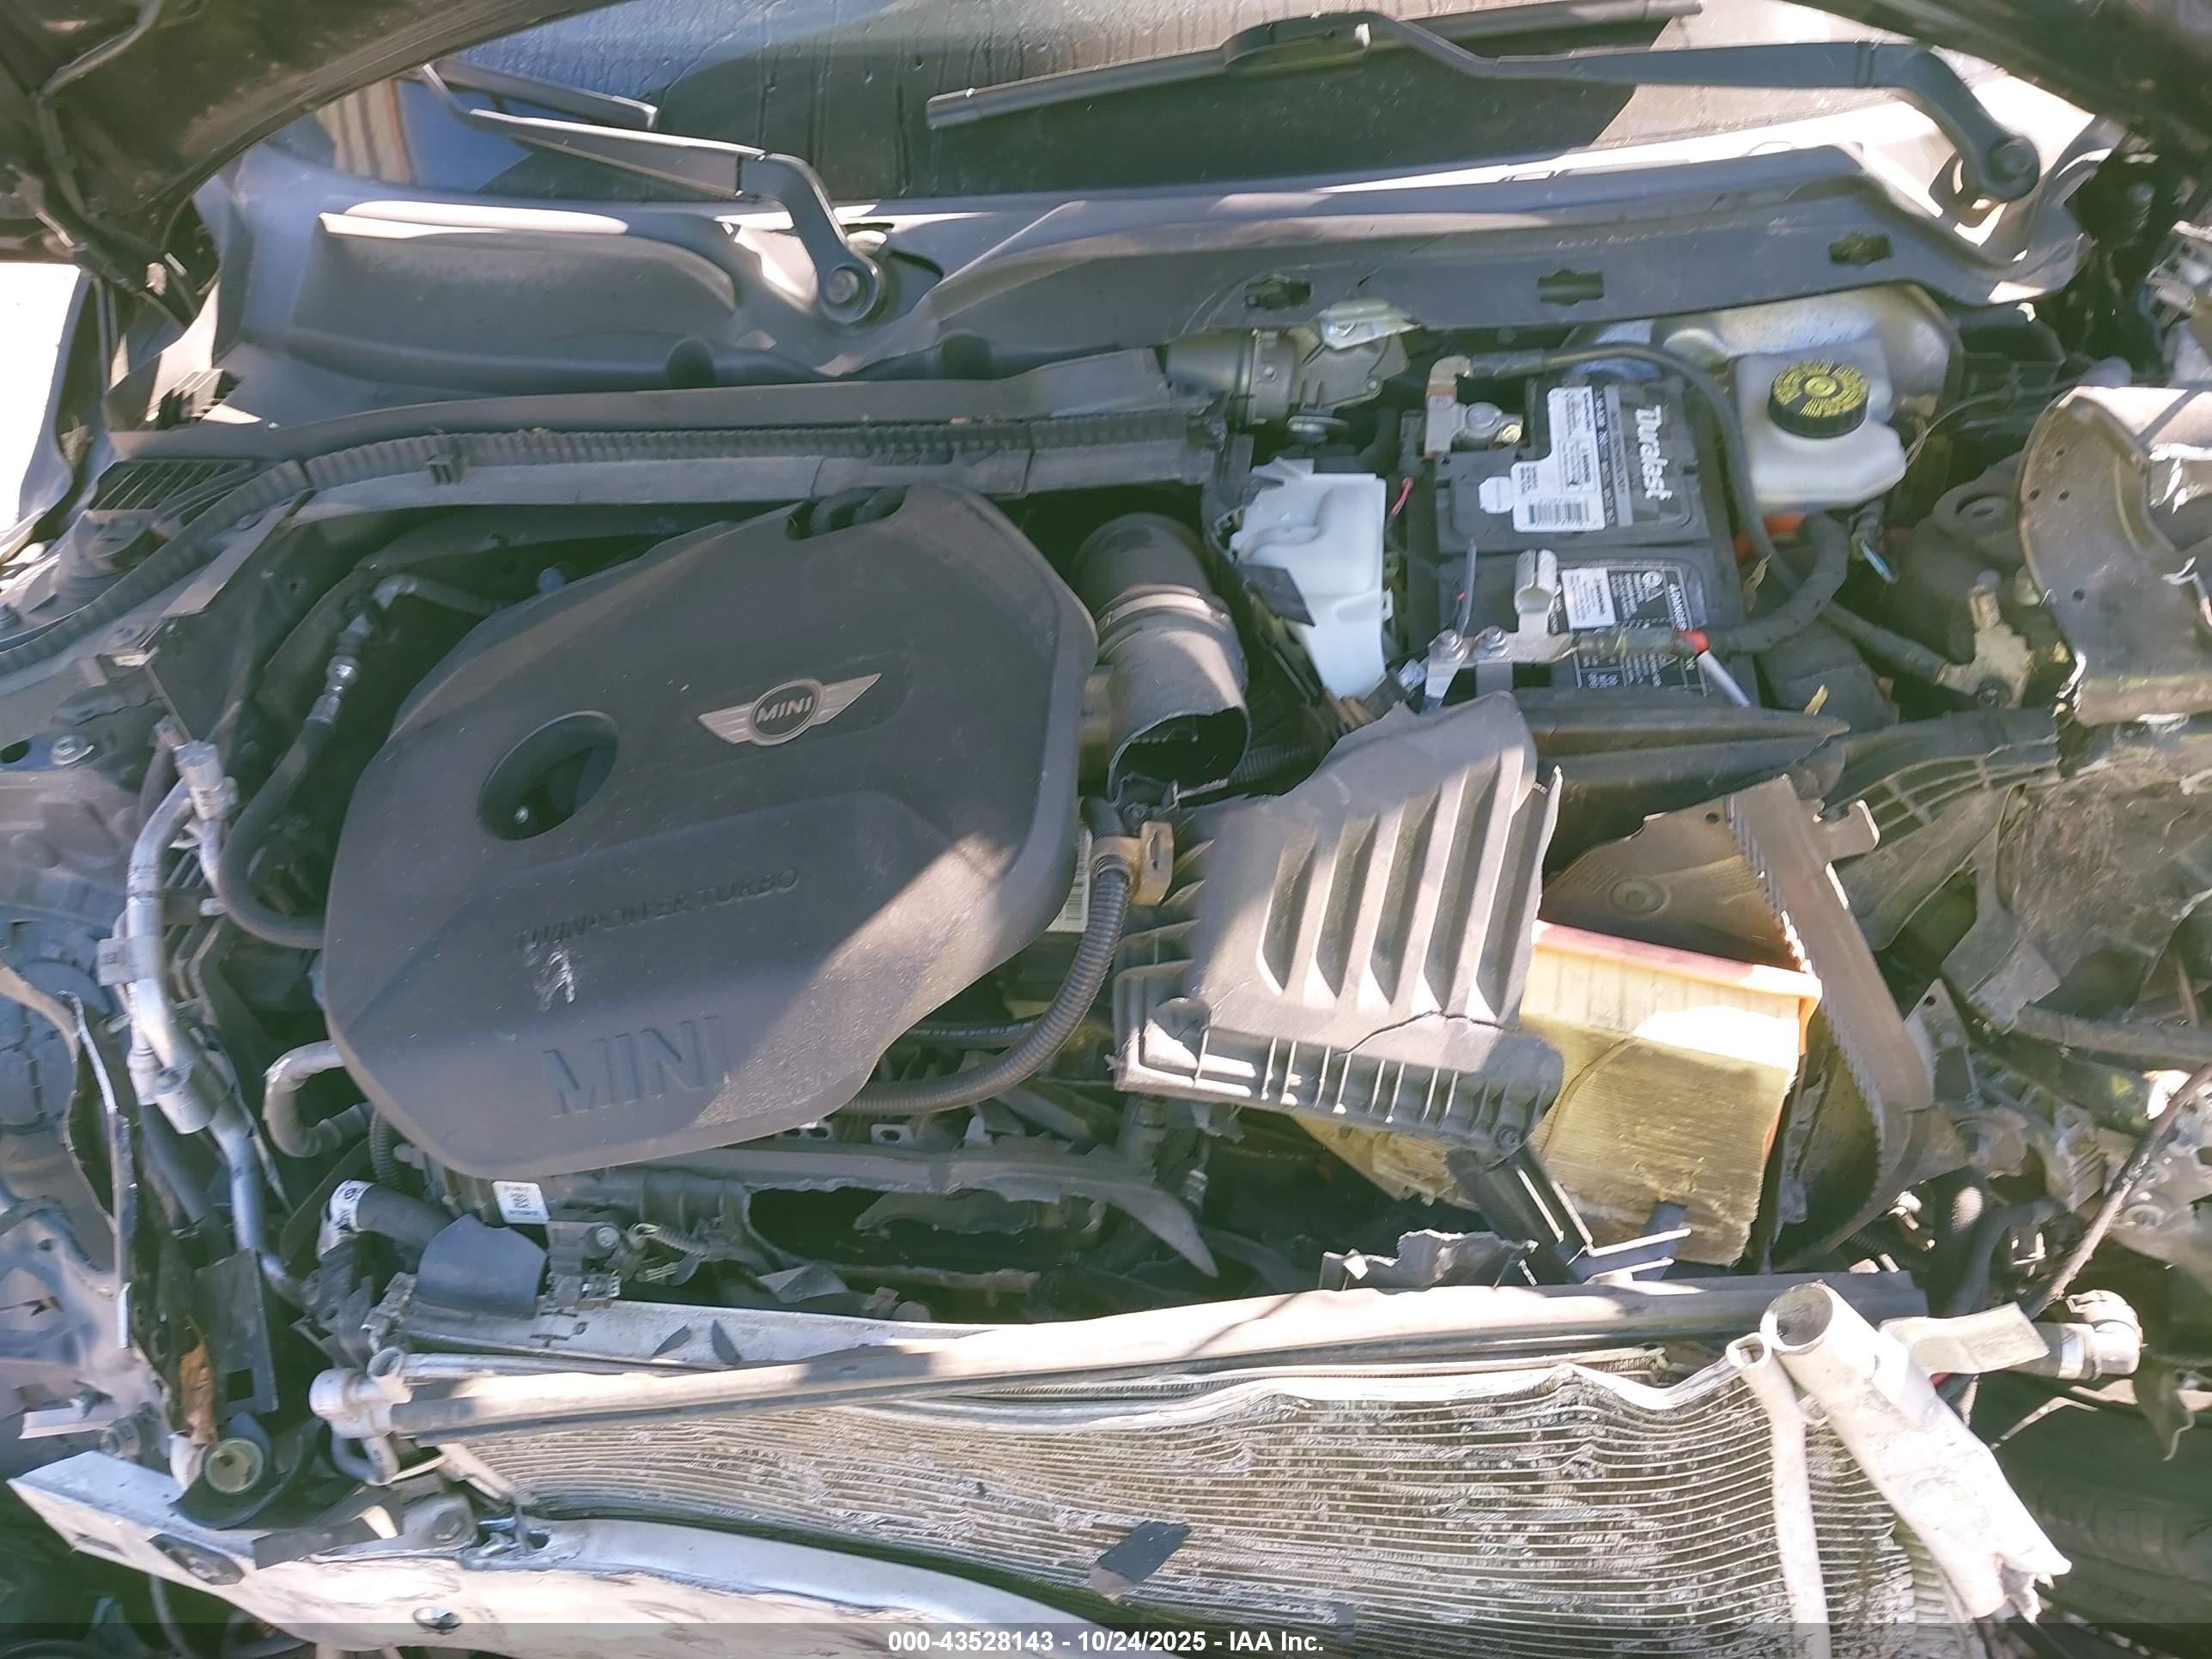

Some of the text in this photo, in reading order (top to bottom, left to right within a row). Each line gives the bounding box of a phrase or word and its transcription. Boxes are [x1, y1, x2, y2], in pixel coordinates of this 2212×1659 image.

[755, 696, 812, 725] MINI
[698, 866, 801, 907] TURBO
[542, 1014, 730, 1119] MINI
